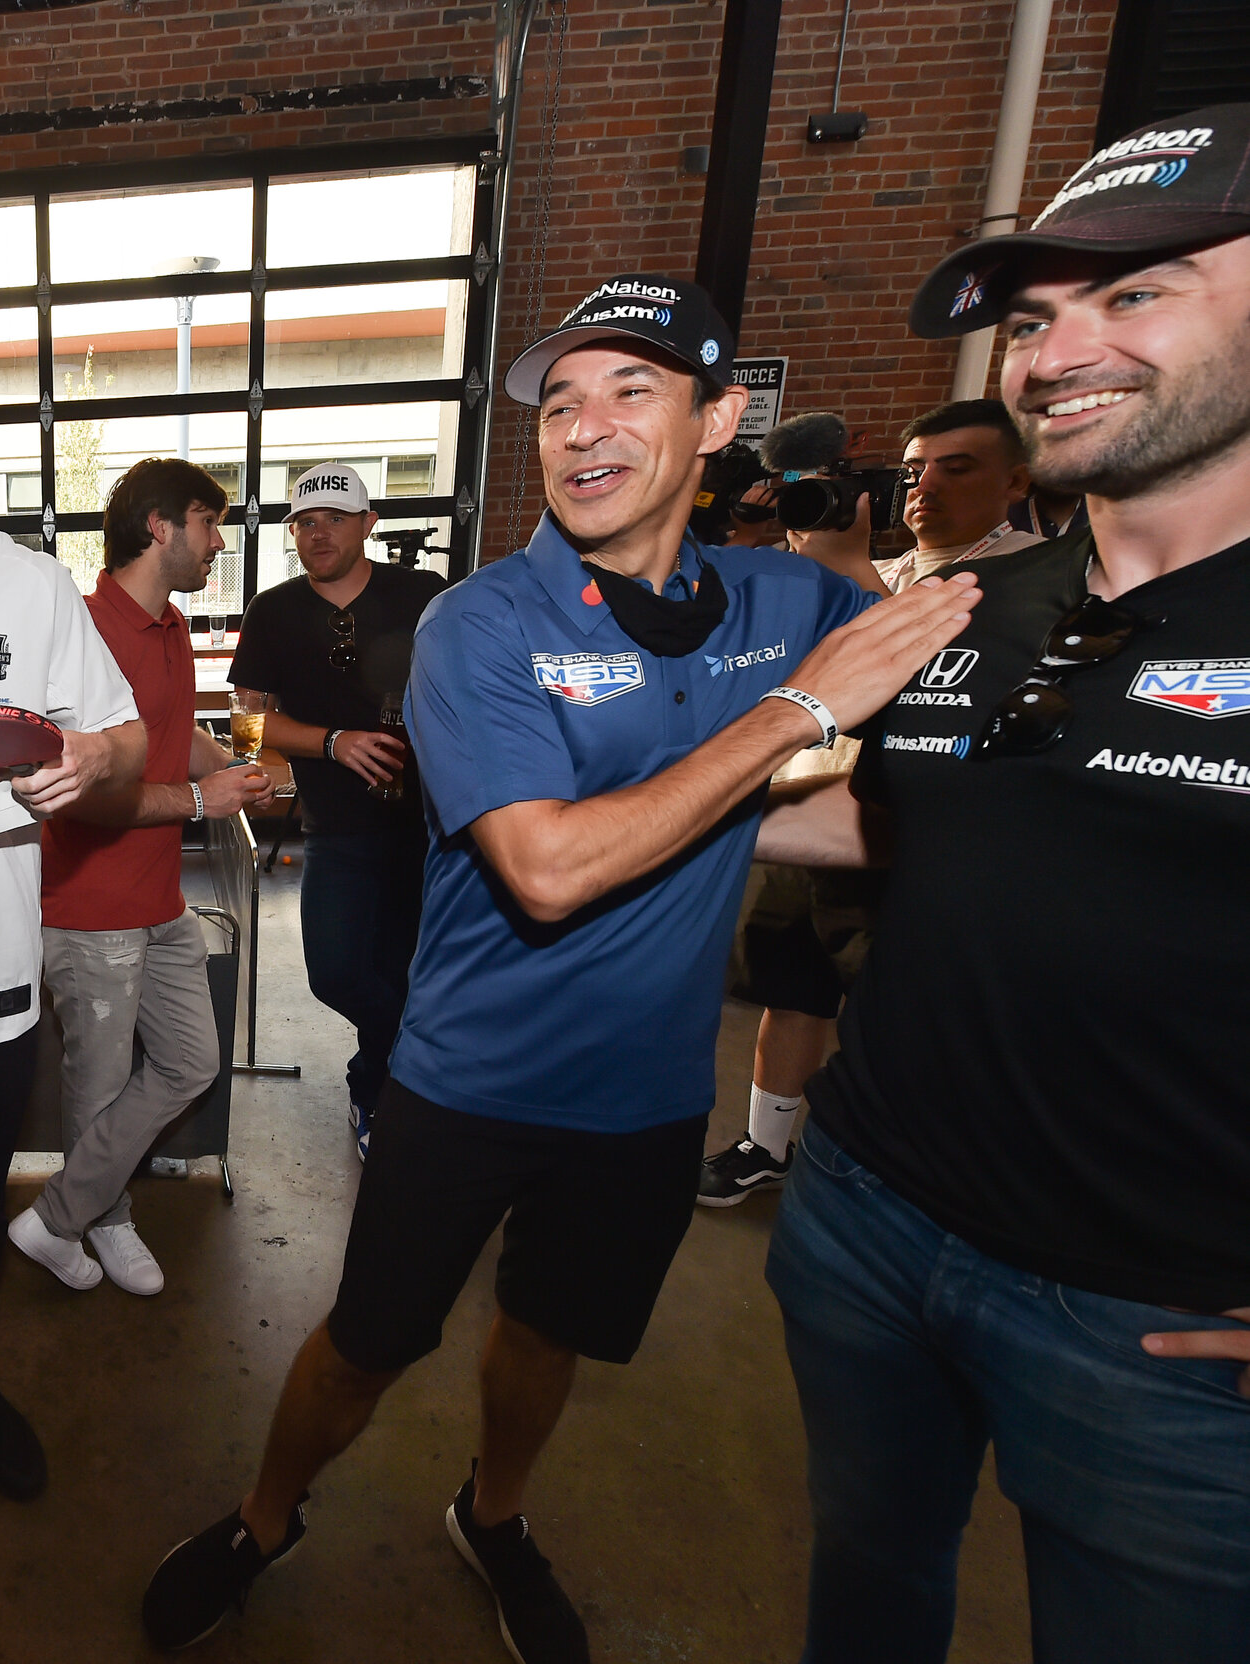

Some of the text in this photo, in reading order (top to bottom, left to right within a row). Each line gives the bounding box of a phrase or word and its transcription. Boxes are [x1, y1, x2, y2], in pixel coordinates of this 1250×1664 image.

[749, 396, 765, 404] OSE
[299, 475, 349, 498] TRKHSE
[562, 655, 601, 665] SHANK
[1145, 663, 1201, 671] MEYER
[536, 664, 639, 684] MSR
[896, 692, 973, 706] HONDA
[1085, 748, 1250, 785] AutoNati
